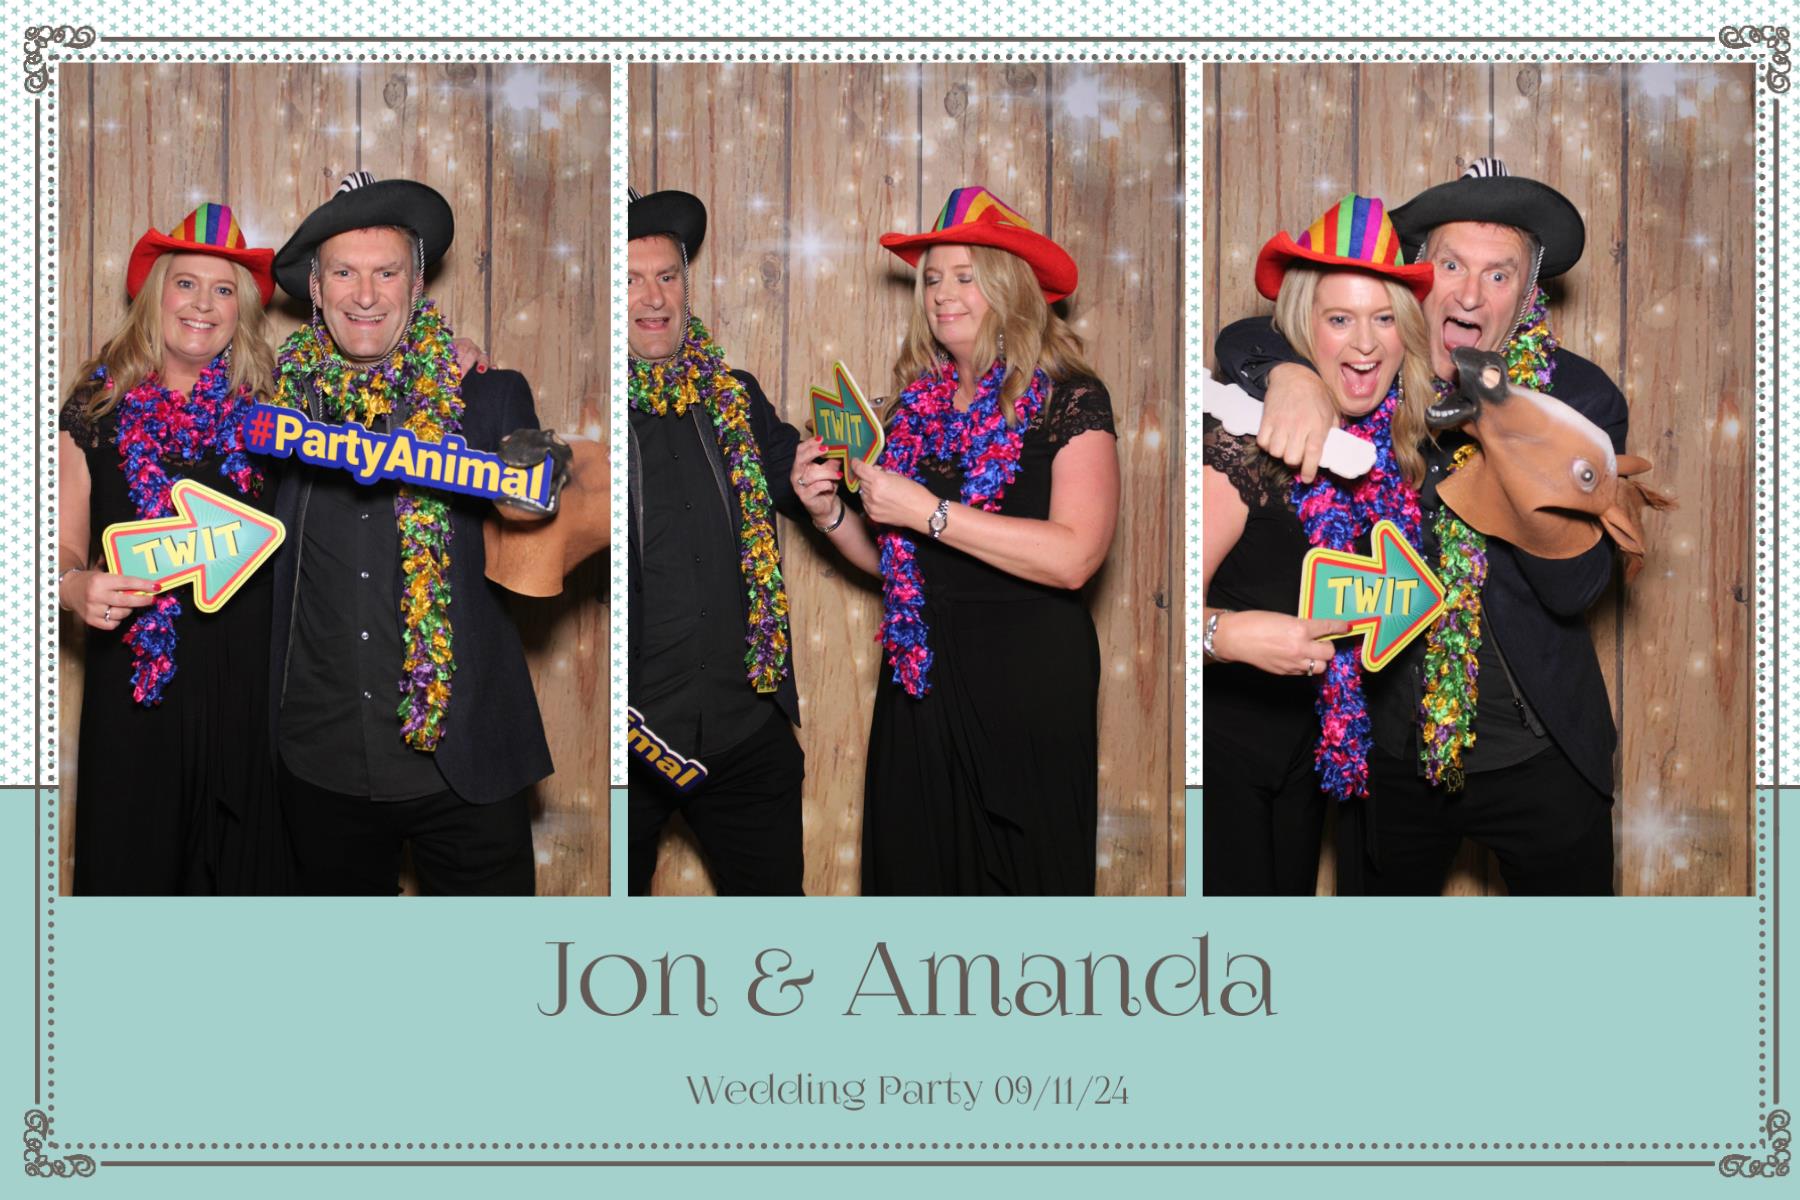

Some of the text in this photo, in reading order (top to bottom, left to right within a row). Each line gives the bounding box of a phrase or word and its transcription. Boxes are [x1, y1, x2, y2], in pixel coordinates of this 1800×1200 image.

[820, 408, 862, 448] TWIT
[249, 411, 545, 500] #PartyAnimal
[132, 520, 242, 575] TWIT
[1327, 576, 1419, 616] TWIT
